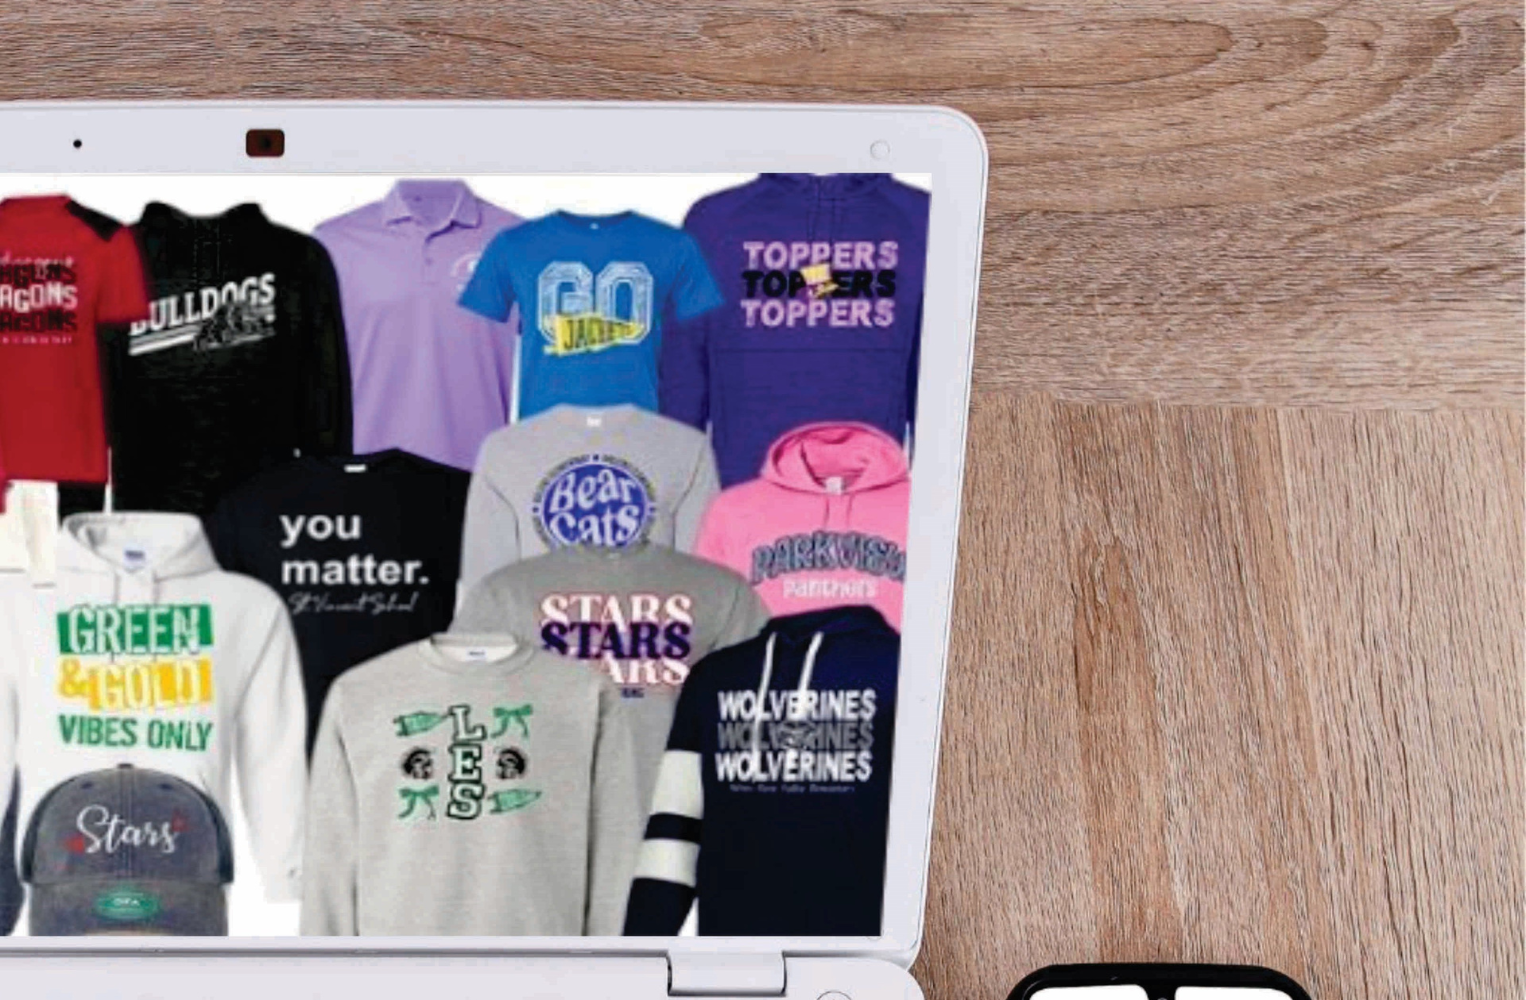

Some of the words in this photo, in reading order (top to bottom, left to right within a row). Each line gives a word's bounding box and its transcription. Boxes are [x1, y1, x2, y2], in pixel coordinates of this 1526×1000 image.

[742, 240, 899, 270] TOPPERS
[741, 269, 897, 298] TOPERS
[537, 260, 654, 346] GO
[740, 298, 896, 328] TOPPERS
[549, 468, 638, 514] Bear
[279, 514, 362, 548] you
[549, 504, 640, 548] Cats
[281, 553, 430, 585] matter.
[68, 603, 202, 655] GREEN
[540, 592, 693, 630] STARS
[540, 620, 692, 660] STARS
[717, 688, 876, 721] WOLVERINES
[58, 713, 139, 747] VIBES
[147, 718, 214, 751] ONLY
[713, 750, 873, 782] WOLVERINES
[76, 804, 178, 855] Stars
